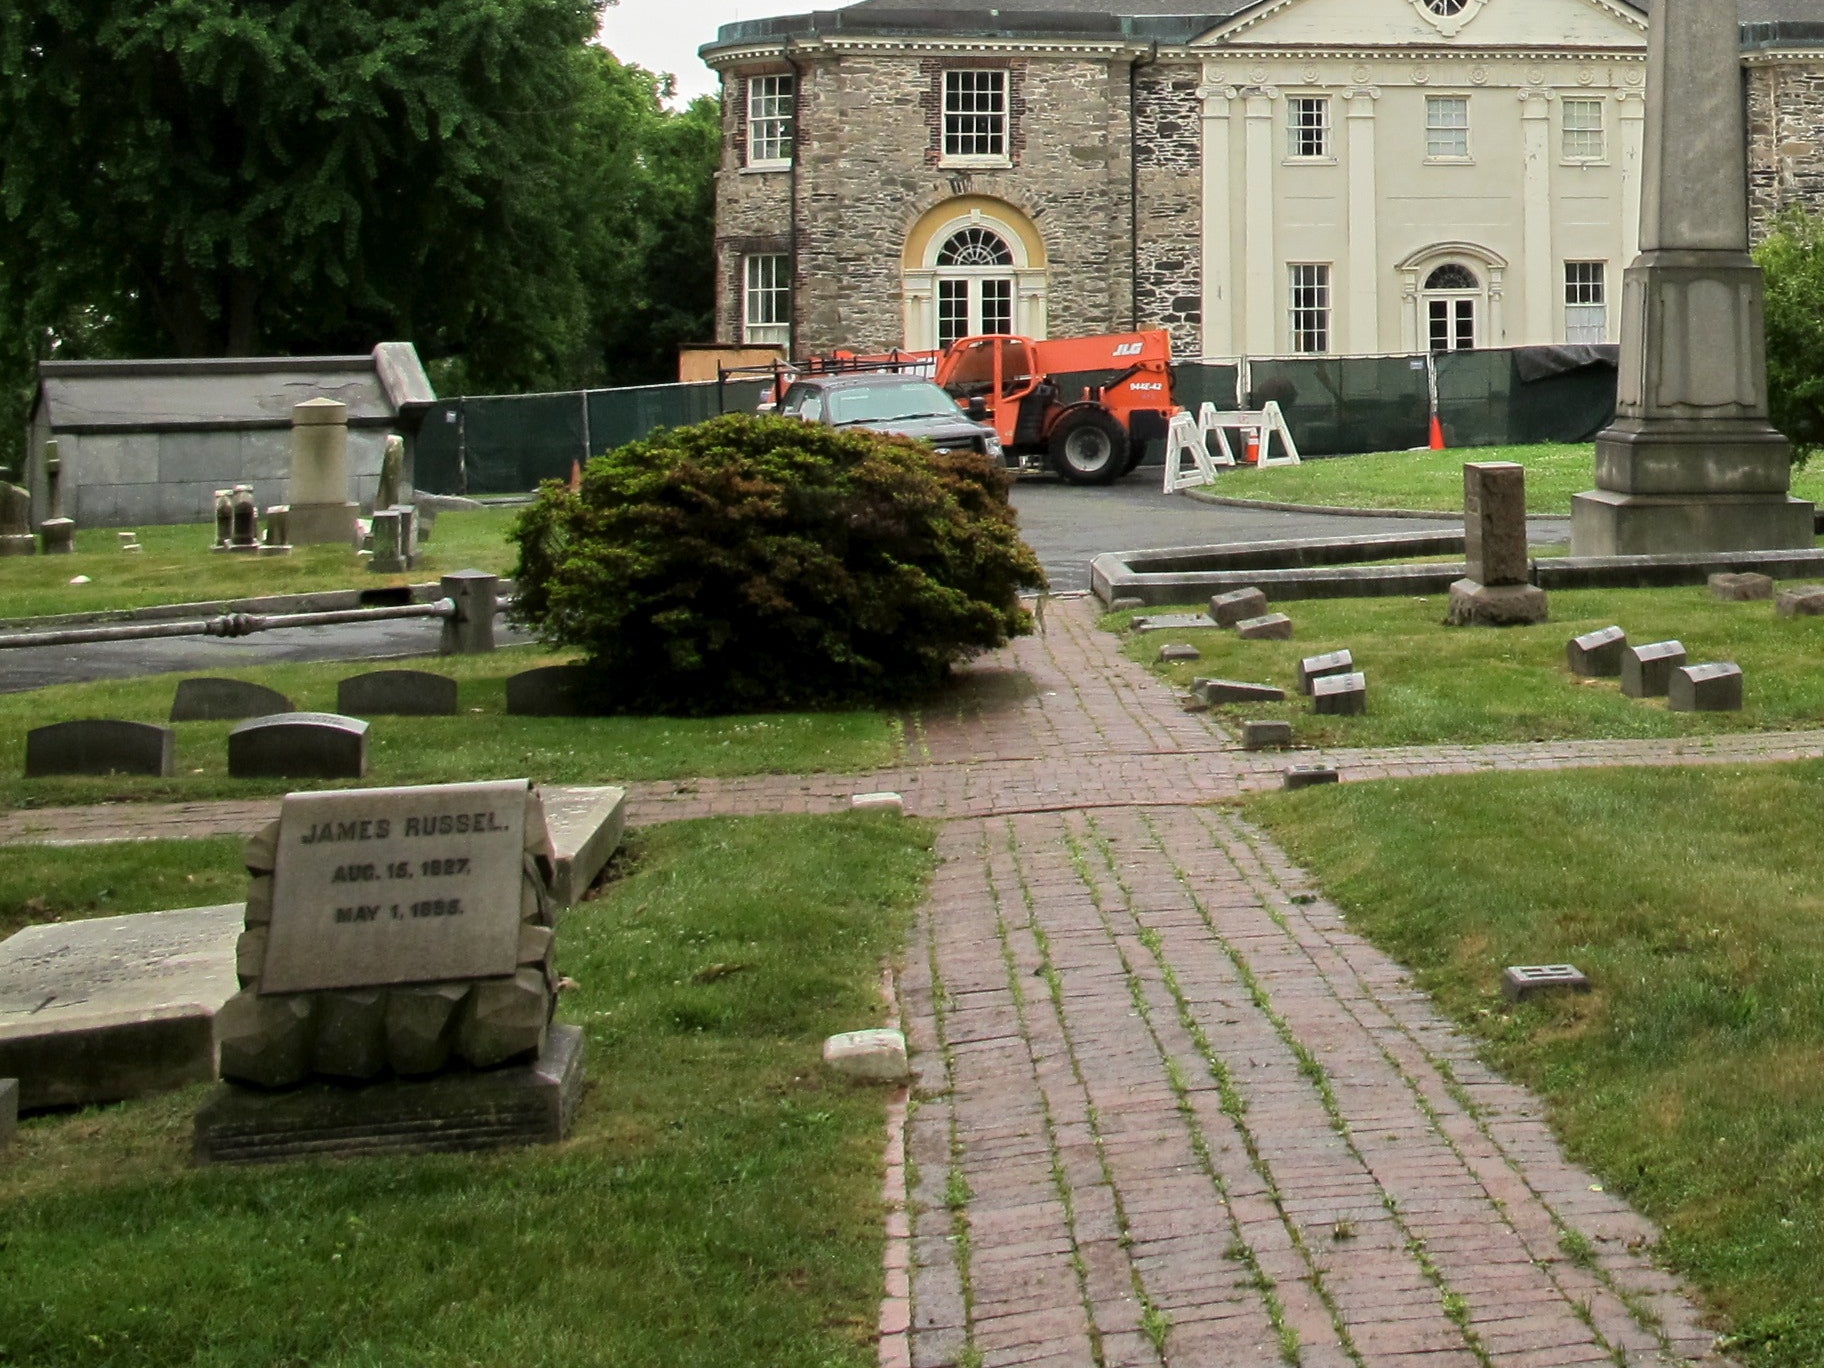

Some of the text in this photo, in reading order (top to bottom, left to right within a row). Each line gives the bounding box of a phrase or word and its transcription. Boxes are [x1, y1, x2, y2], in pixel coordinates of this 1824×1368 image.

[1111, 342, 1144, 357] JLG
[301, 811, 509, 844] JAMES RUSSEL.
[331, 863, 381, 883] AUG.
[335, 904, 381, 923] MAY
